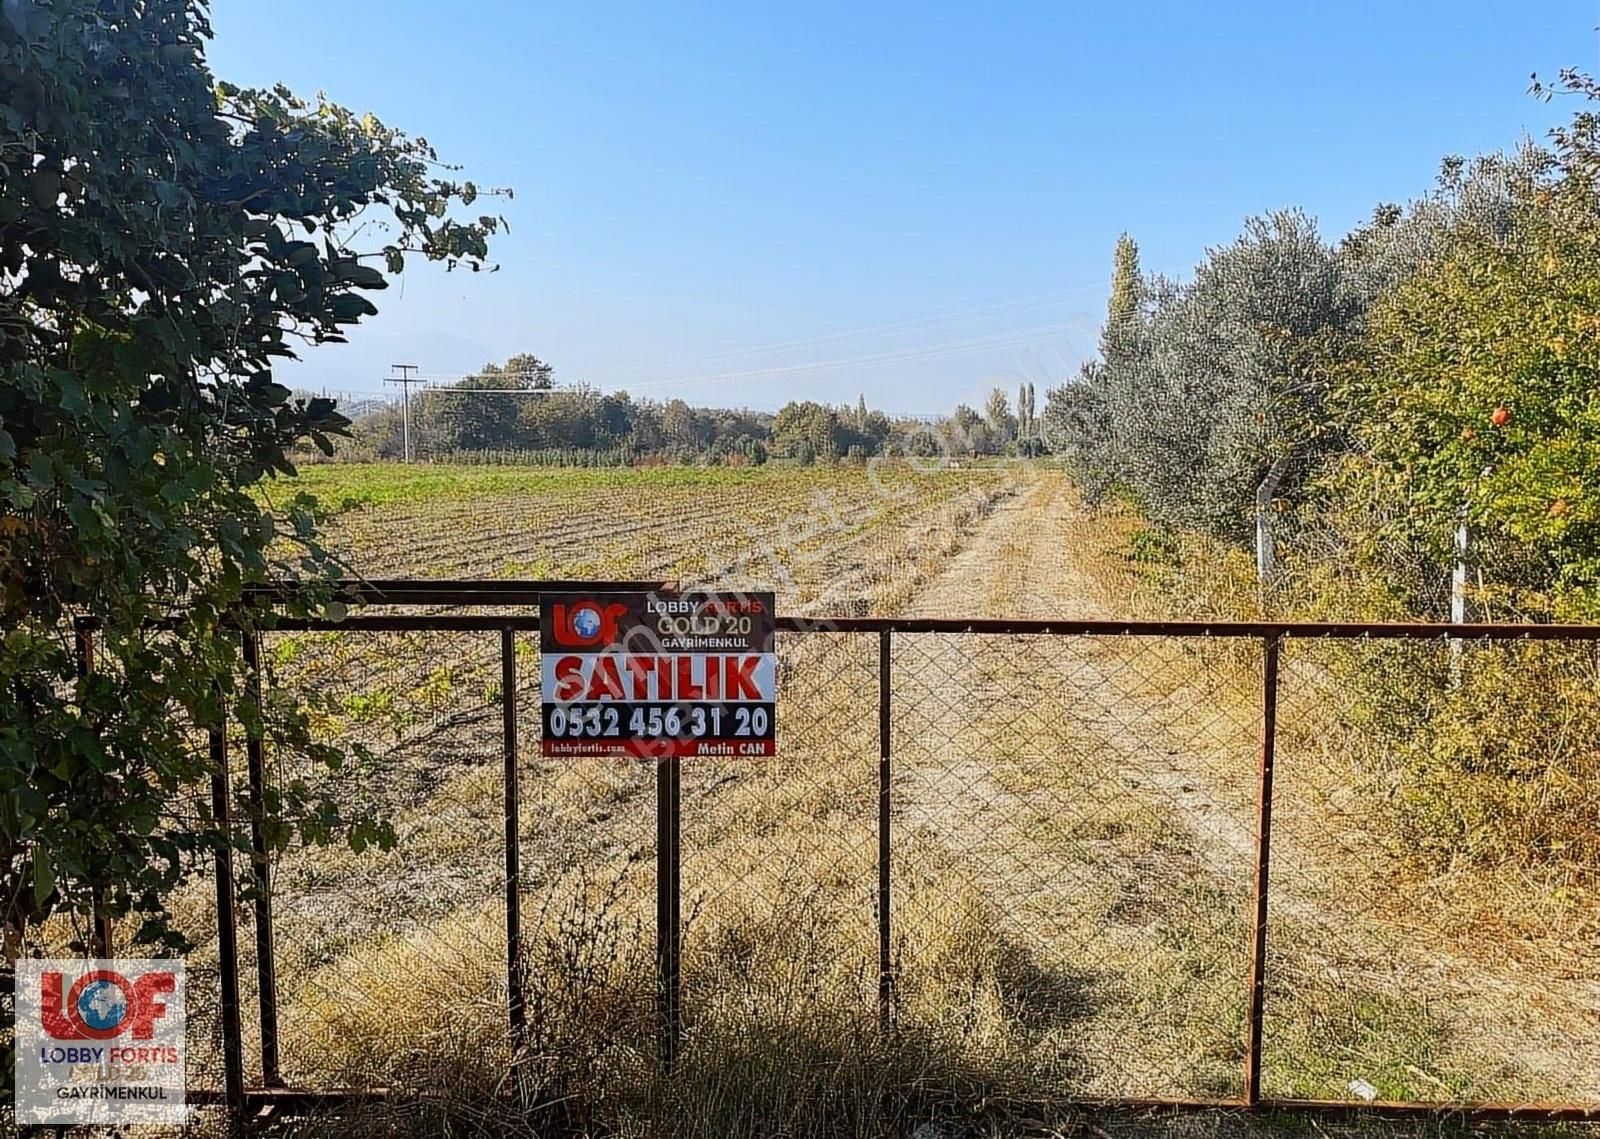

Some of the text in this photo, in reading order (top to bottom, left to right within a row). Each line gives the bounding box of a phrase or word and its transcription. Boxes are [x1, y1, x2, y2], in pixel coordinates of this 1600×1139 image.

[647, 600, 699, 613] LOBBY
[657, 616, 752, 635] GOLD 20
[661, 635, 749, 648] GAYRİMENKUL
[554, 655, 763, 701] SATILIK
[550, 707, 768, 737] 0532 456 31 20
[697, 743, 765, 755] Metin CAN
